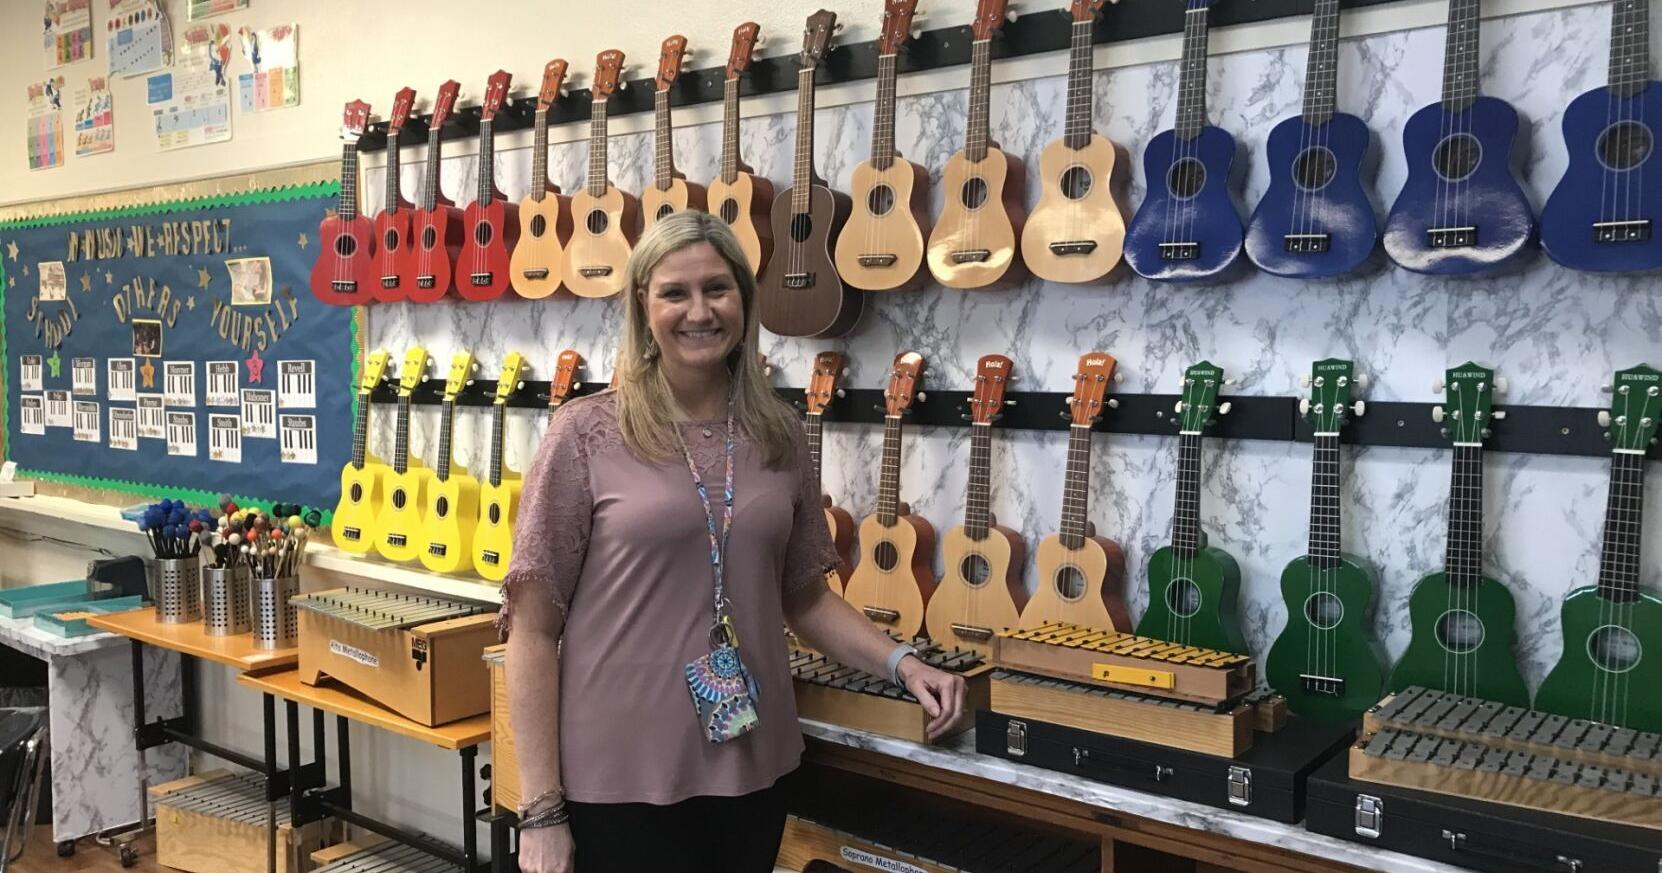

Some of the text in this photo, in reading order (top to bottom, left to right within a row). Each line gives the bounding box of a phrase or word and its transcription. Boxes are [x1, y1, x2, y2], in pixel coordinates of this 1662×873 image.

[84, 226, 123, 260] MUSIC
[131, 224, 155, 258] WE
[113, 275, 182, 329] OTHERS
[210, 297, 298, 352] YOURSELF
[843, 847, 874, 864] Soprano
